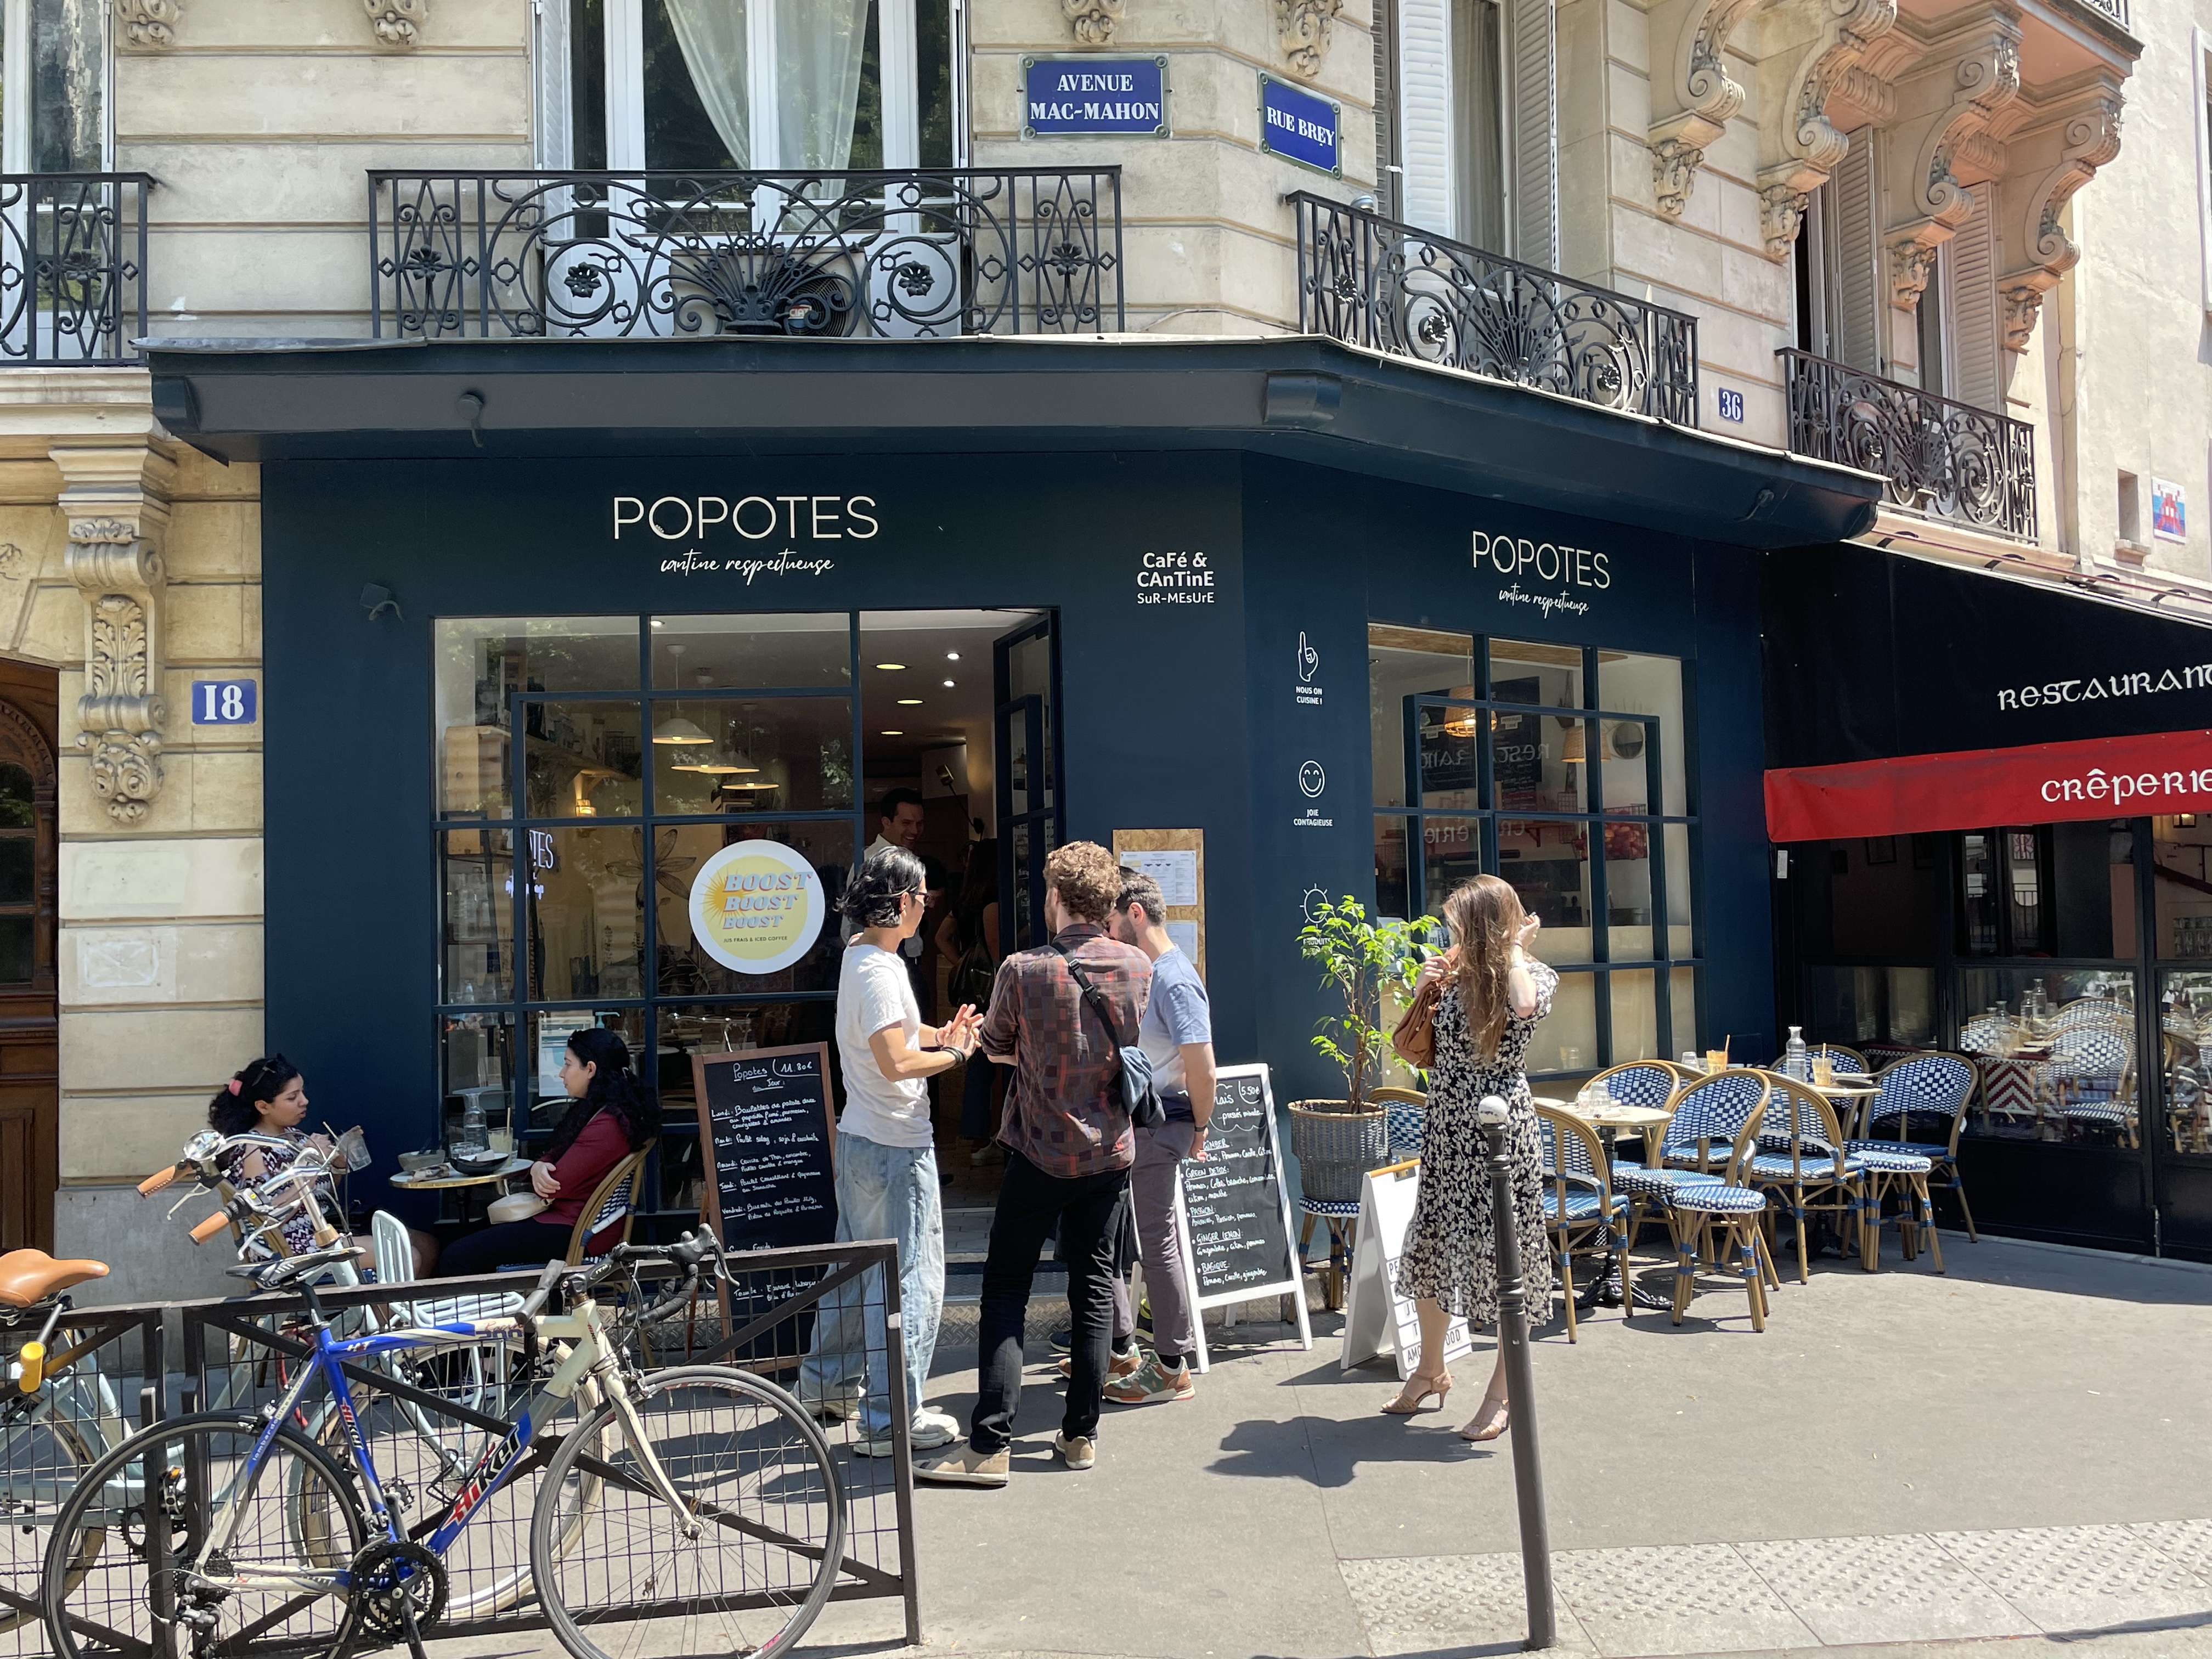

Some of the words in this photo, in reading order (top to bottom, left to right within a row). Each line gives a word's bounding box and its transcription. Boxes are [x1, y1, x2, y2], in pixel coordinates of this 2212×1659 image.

[1057, 74, 1133, 92] AVENUE
[1030, 102, 1159, 120] MAC-MAHON
[1266, 106, 1295, 132] RUE
[1299, 119, 1335, 146] BREY
[1722, 391, 1741, 420] 36
[613, 496, 878, 540] POPOTES
[661, 549, 720, 576] cantine
[725, 548, 834, 585] respectueuse
[1193, 552, 1207, 568] &
[1473, 531, 1610, 589] POPOTES
[1499, 583, 1531, 606] cantine
[1533, 590, 1589, 619] respectueuse
[1296, 686, 1312, 694] NOUS
[204, 685, 244, 720] 18
[1297, 696, 1319, 704] CUISINE
[1306, 809, 1319, 817] JOIE
[723, 871, 813, 893] BOOST
[723, 894, 799, 912] BOOST
[723, 915, 784, 929] BOOST
[733, 1063, 768, 1080] Popotes
